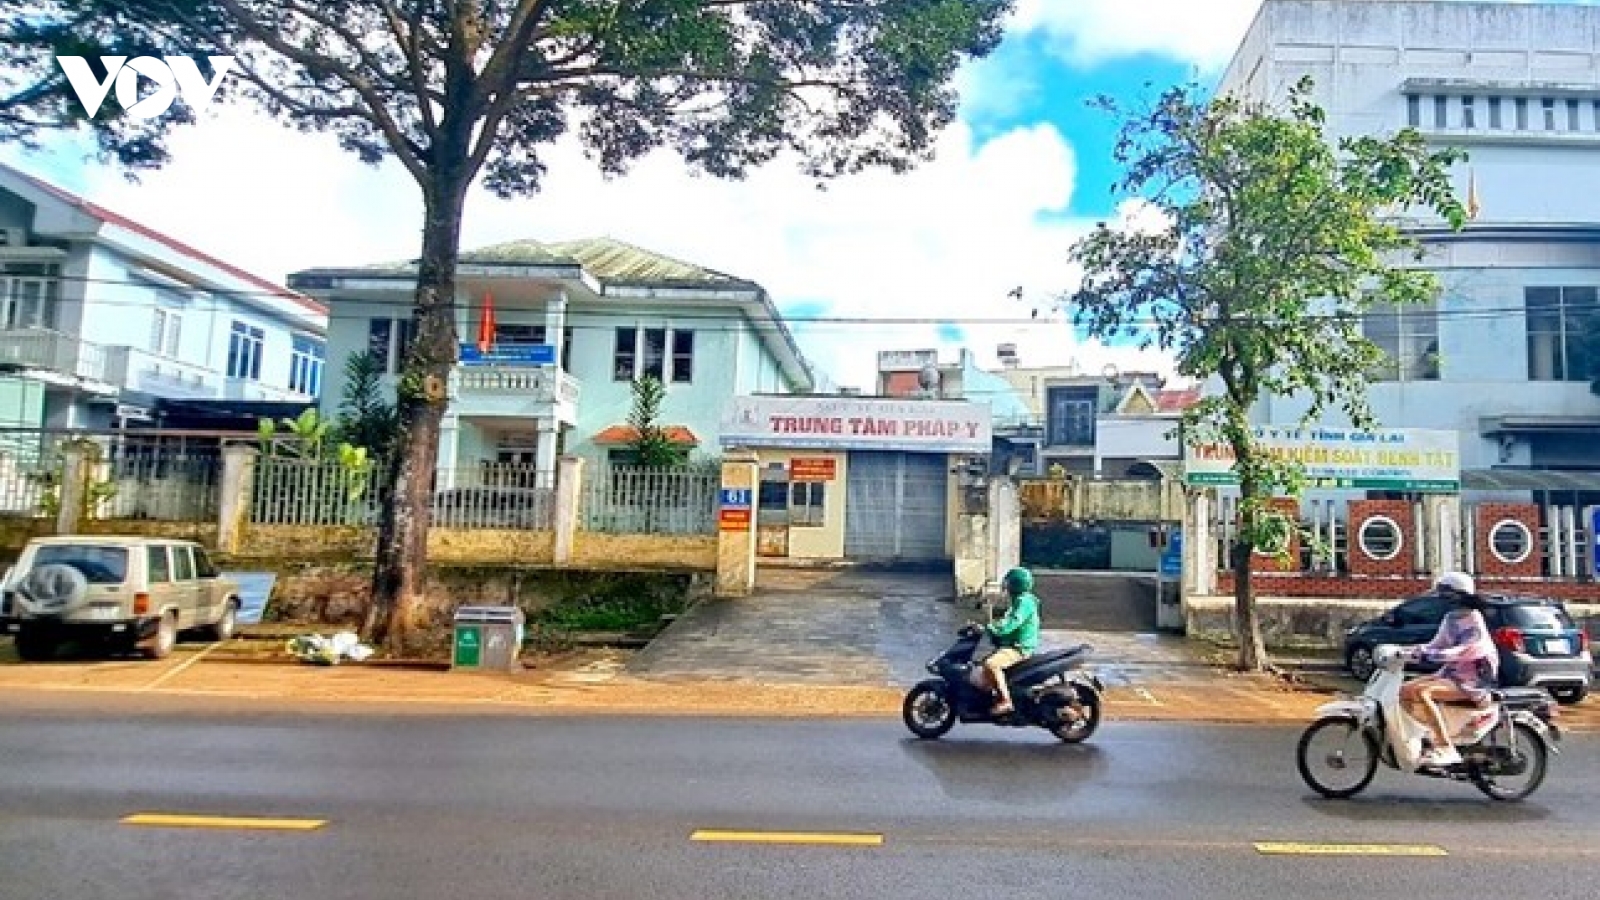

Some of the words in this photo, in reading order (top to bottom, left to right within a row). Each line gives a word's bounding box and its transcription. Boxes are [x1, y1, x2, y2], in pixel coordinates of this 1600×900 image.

[769, 416, 842, 434] TRUNG
[848, 415, 897, 436] TÂM
[967, 421, 980, 438] Y
[728, 489, 745, 503] 61
